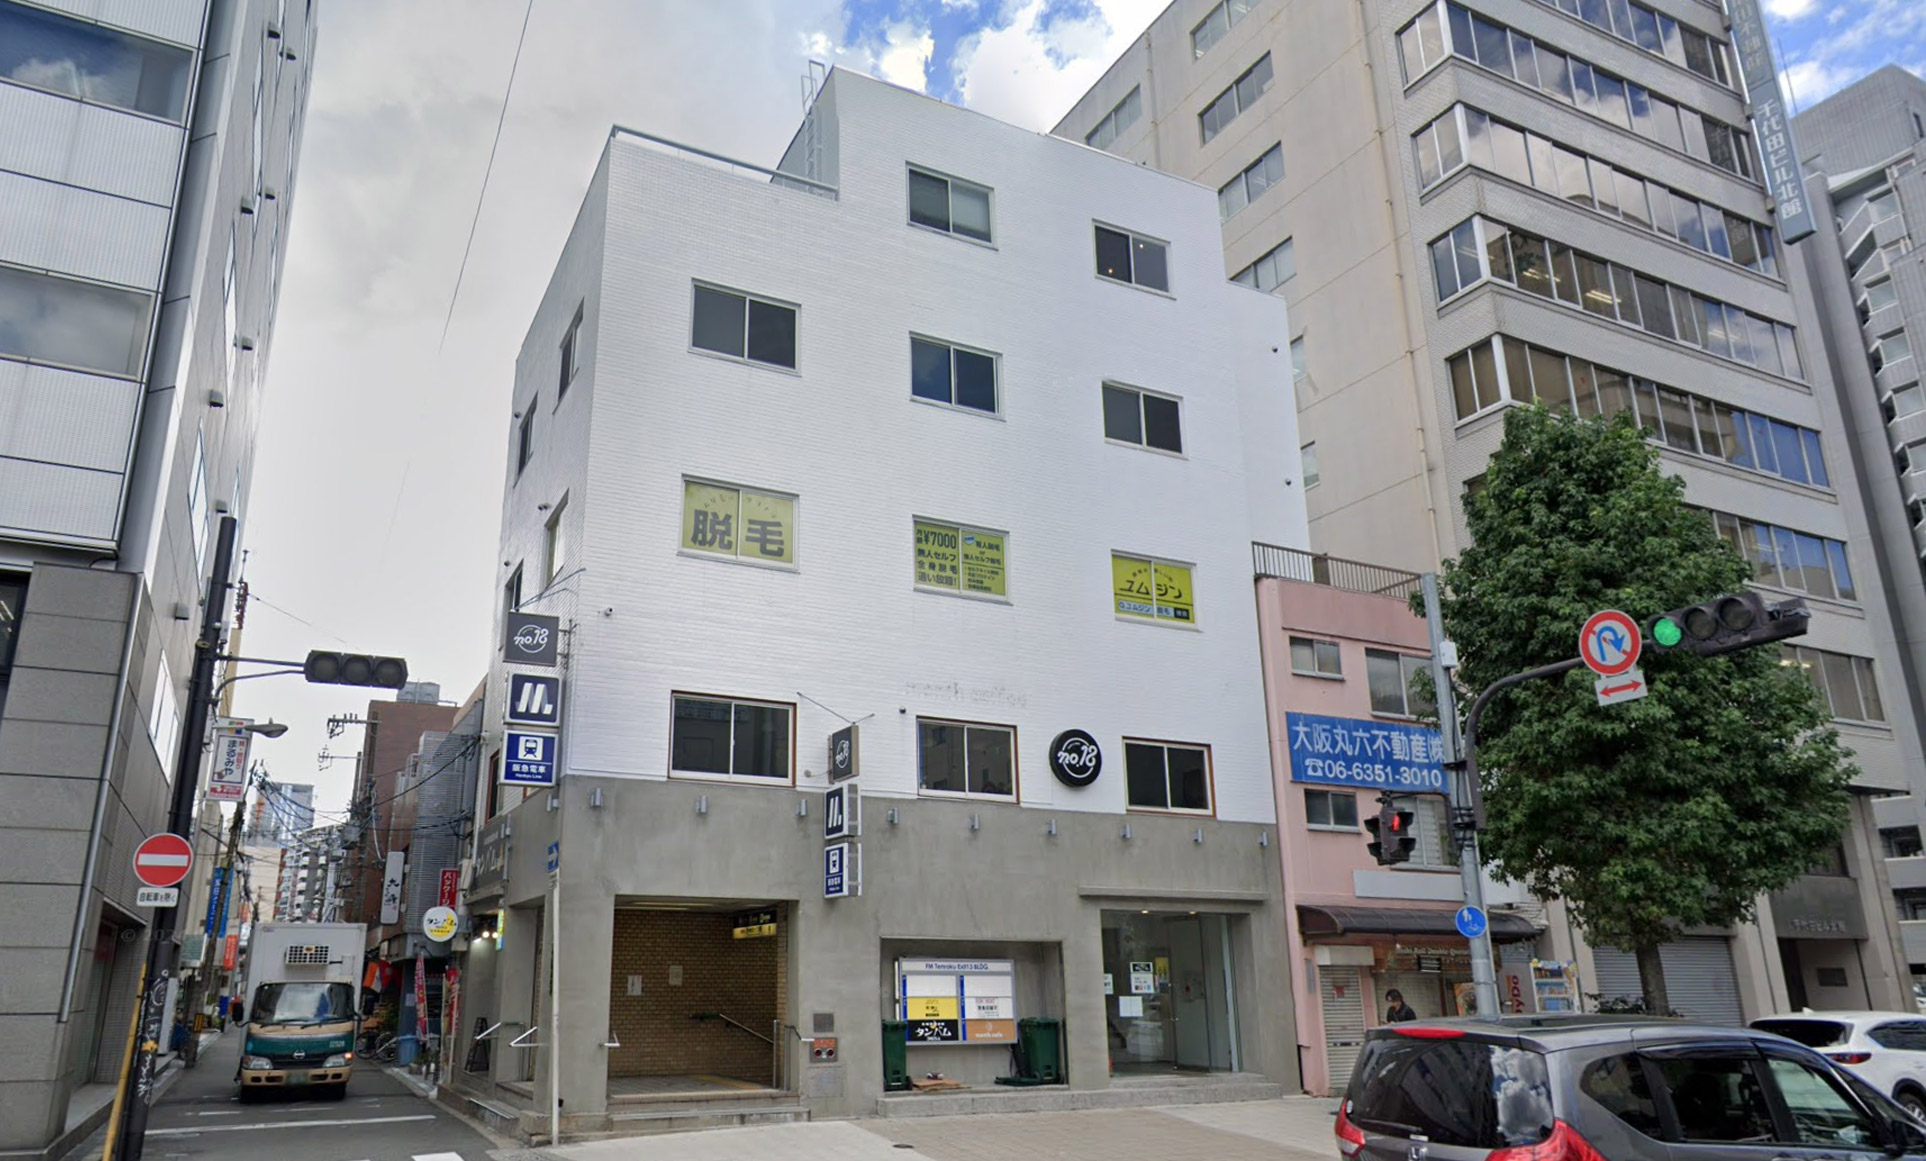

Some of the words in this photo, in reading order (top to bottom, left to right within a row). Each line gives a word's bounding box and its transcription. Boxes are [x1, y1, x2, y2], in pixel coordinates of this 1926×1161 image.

[1757, 99, 1803, 220] 千代田ビル北館
[690, 508, 785, 558] 脱毛
[924, 530, 957, 550] ¥7000
[1119, 579, 1183, 599] ユムジン
[1292, 720, 1446, 764] 大阪丸六不動産(株
[1057, 744, 1098, 768] no.18
[1324, 759, 1443, 788] 06-6351-3010
[915, 1025, 951, 1037] タンバム
